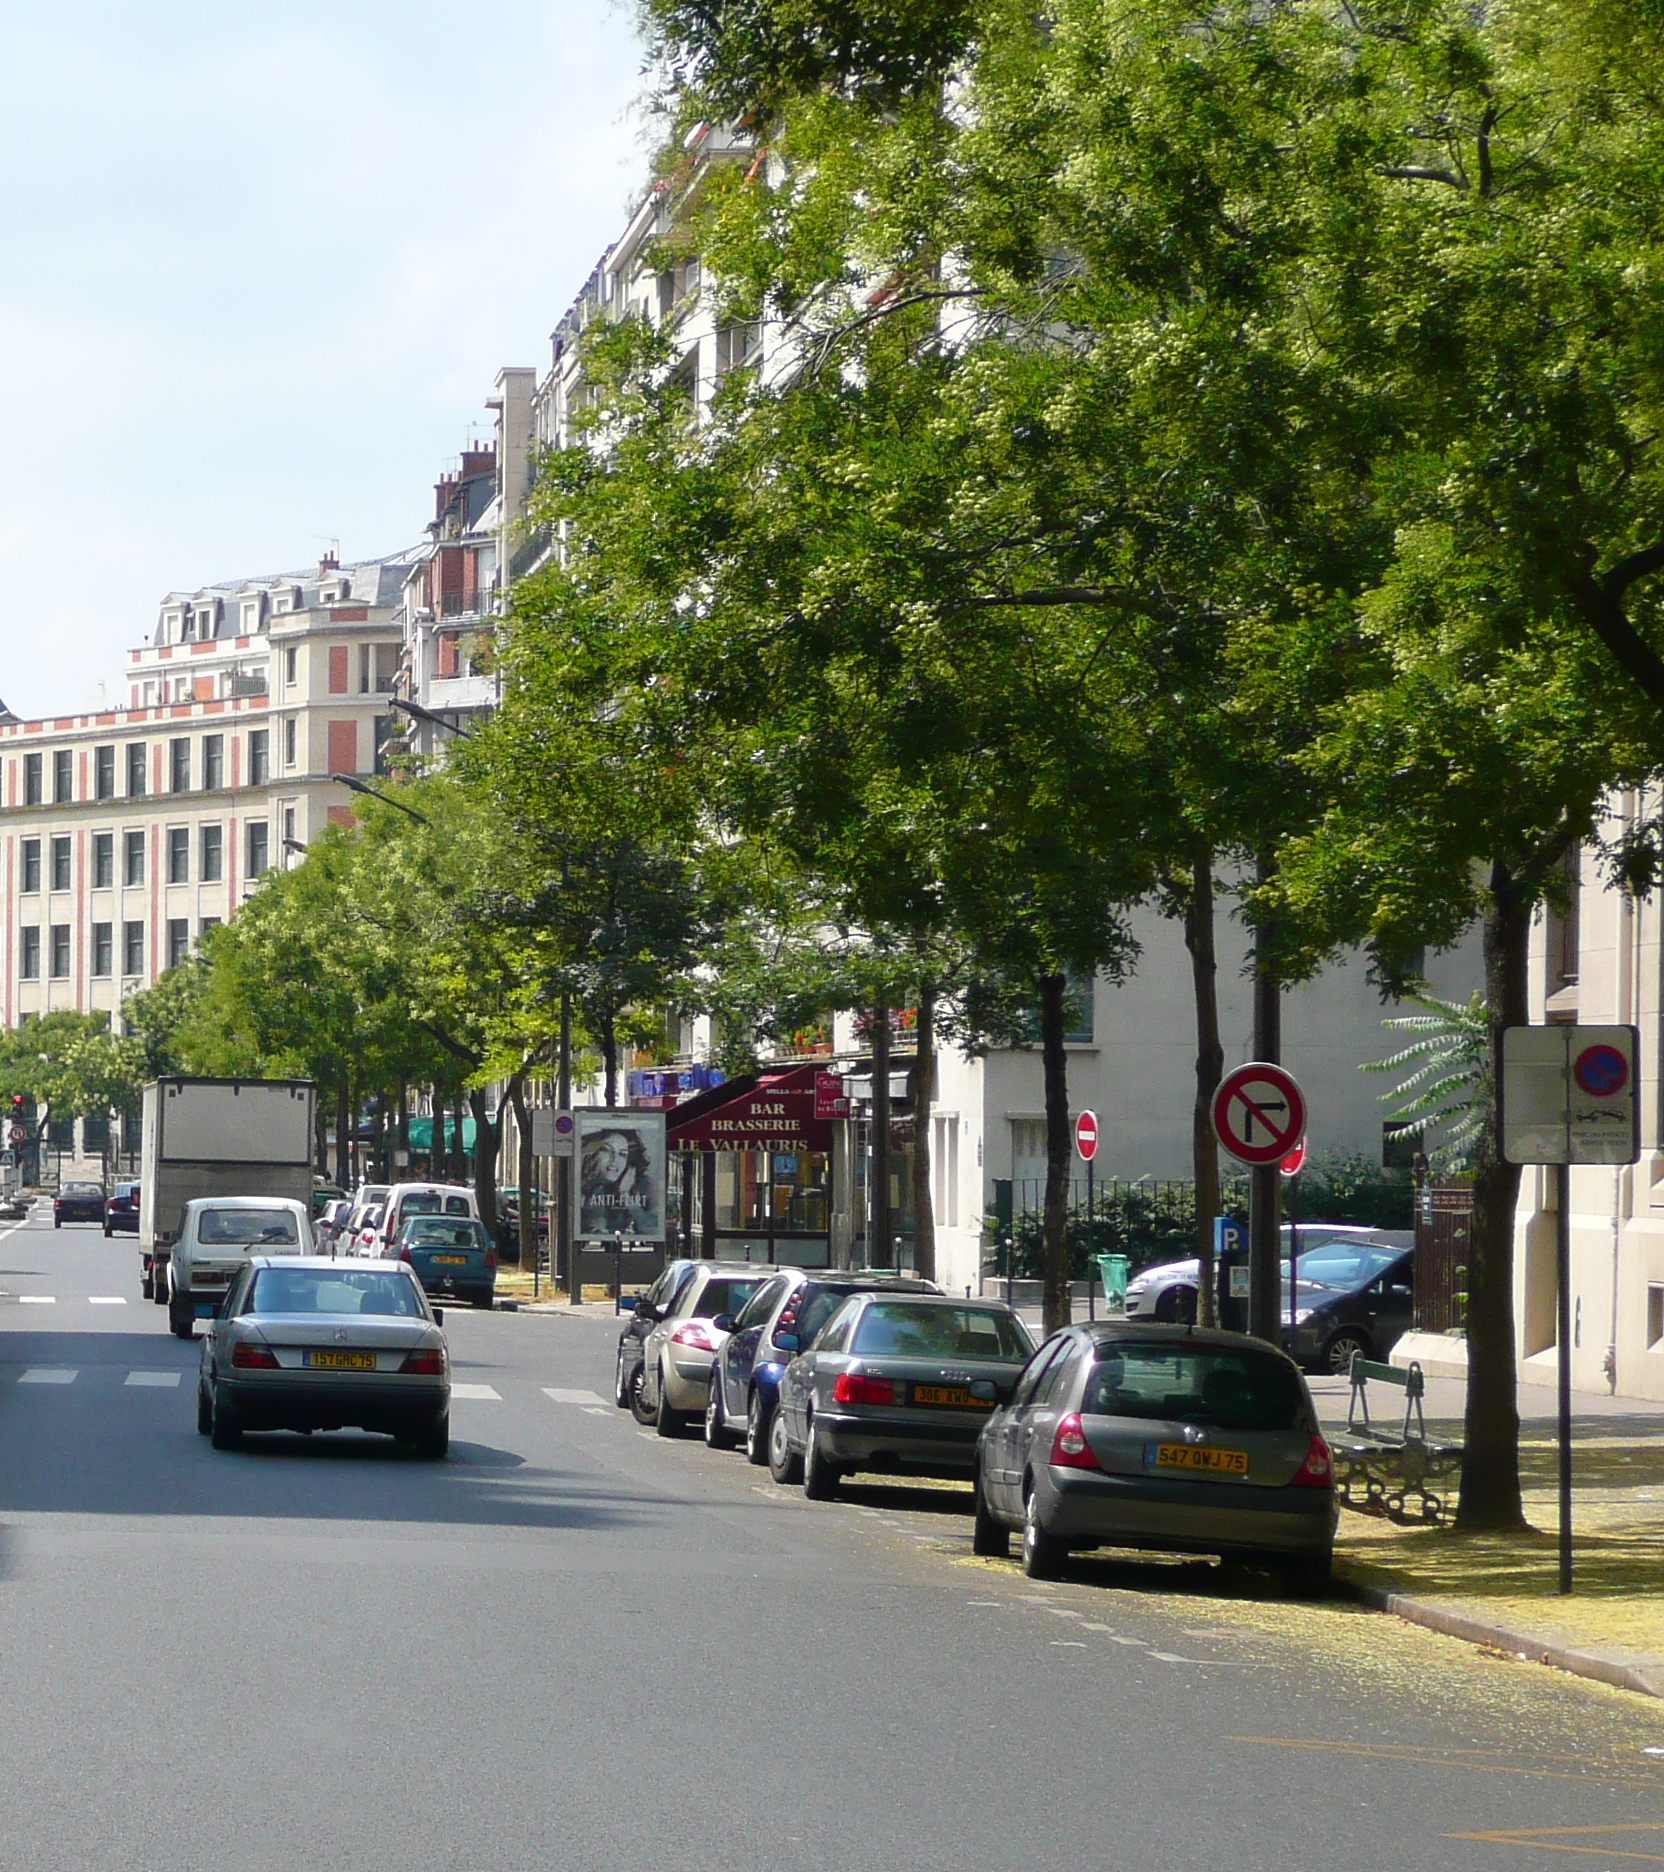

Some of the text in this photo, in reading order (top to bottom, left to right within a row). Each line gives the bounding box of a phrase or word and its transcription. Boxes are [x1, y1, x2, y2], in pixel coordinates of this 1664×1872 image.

[751, 1103, 785, 1115] BAR
[711, 1119, 801, 1131] BRASSERIE
[678, 1138, 808, 1151] LE VALLAURIS
[590, 1194, 647, 1207] ANTI-FLIRT
[1223, 1227, 1239, 1250] P
[312, 1353, 334, 1365] 157
[359, 1354, 374, 1367] 75
[919, 1388, 940, 1401] 306
[1159, 1448, 1244, 1469] 547 QWJ 75
